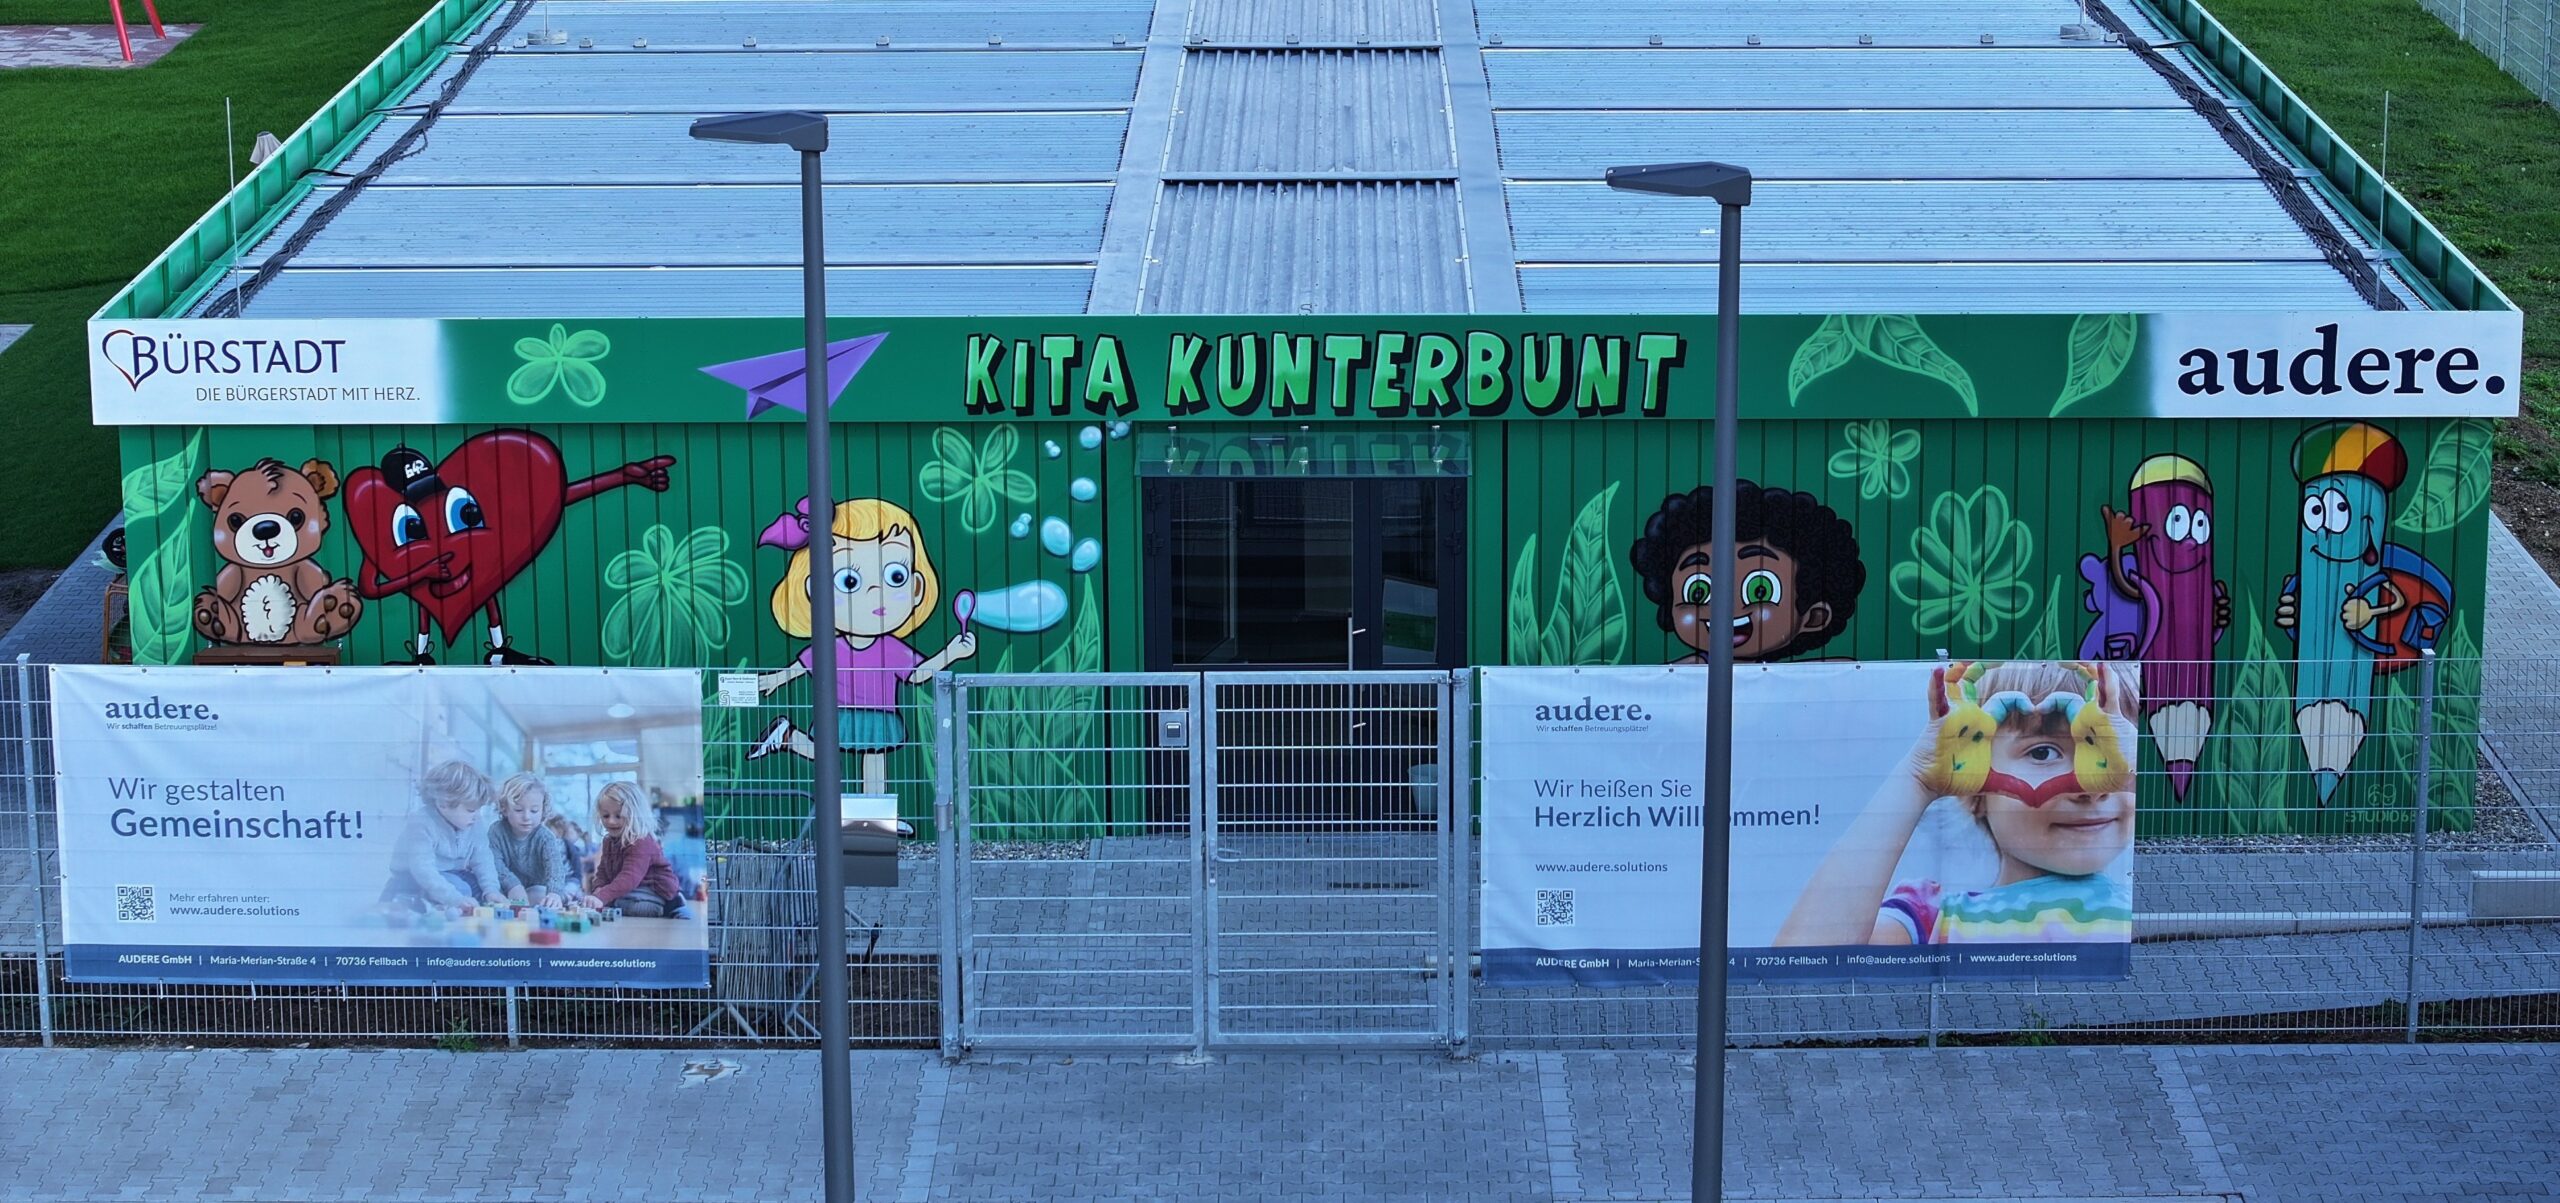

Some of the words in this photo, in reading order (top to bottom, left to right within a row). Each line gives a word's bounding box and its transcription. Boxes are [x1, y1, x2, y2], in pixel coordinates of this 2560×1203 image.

[131, 333, 346, 378] BÜRSTADT
[2178, 323, 2506, 396] audere.
[964, 332, 1138, 418] KITA
[1164, 330, 1688, 418] KUNTERBUNT
[196, 387, 221, 401] DIE
[226, 385, 336, 401] BÜRGERSTADT
[342, 387, 370, 401] MIT
[375, 387, 421, 401] HERZ.
[105, 695, 219, 720] audere.
[1535, 696, 1652, 722] audere.
[106, 722, 121, 730] Wir
[122, 722, 153, 730] schaffen
[154, 722, 217, 731] Betreuungsplätze!
[1585, 725, 1649, 733] Betreuungsplätze!
[108, 777, 157, 799] Wir
[165, 778, 285, 805] gestalten
[1534, 779, 1574, 797] Wir
[1581, 779, 1653, 797] heißen
[1661, 779, 1692, 797] Sie
[111, 808, 364, 839] Gemeinschaft!
[1535, 806, 1641, 827] Herzlich
[1648, 804, 1820, 827] Willmmen!
[1535, 862, 1668, 873] www.audere.solutions
[169, 893, 196, 903] Mehr
[197, 893, 239, 903] erfahren
[241, 895, 270, 903] unter:
[170, 905, 300, 917] www.audere.solutions
[118, 954, 160, 964] AUDERE
[161, 954, 192, 964] GmbH
[210, 955, 308, 966] Maria-Merian-Straße
[310, 956, 316, 965] 4
[336, 956, 367, 966] 70736
[369, 956, 408, 966] Fellbach
[427, 957, 531, 968] info@audere.solutions
[550, 958, 656, 968] www.audere.solutions
[1536, 957, 1577, 969] AUDERE
[1579, 958, 1610, 968] GmbH
[1628, 957, 1700, 968] Maria-Merian-S
[1729, 957, 1735, 966] 4
[1756, 957, 1786, 966] 70736
[1789, 956, 1828, 966] Fellbach
[1847, 954, 1951, 965] info@audere.solutions
[1970, 953, 2077, 963] www.audere.solutions
